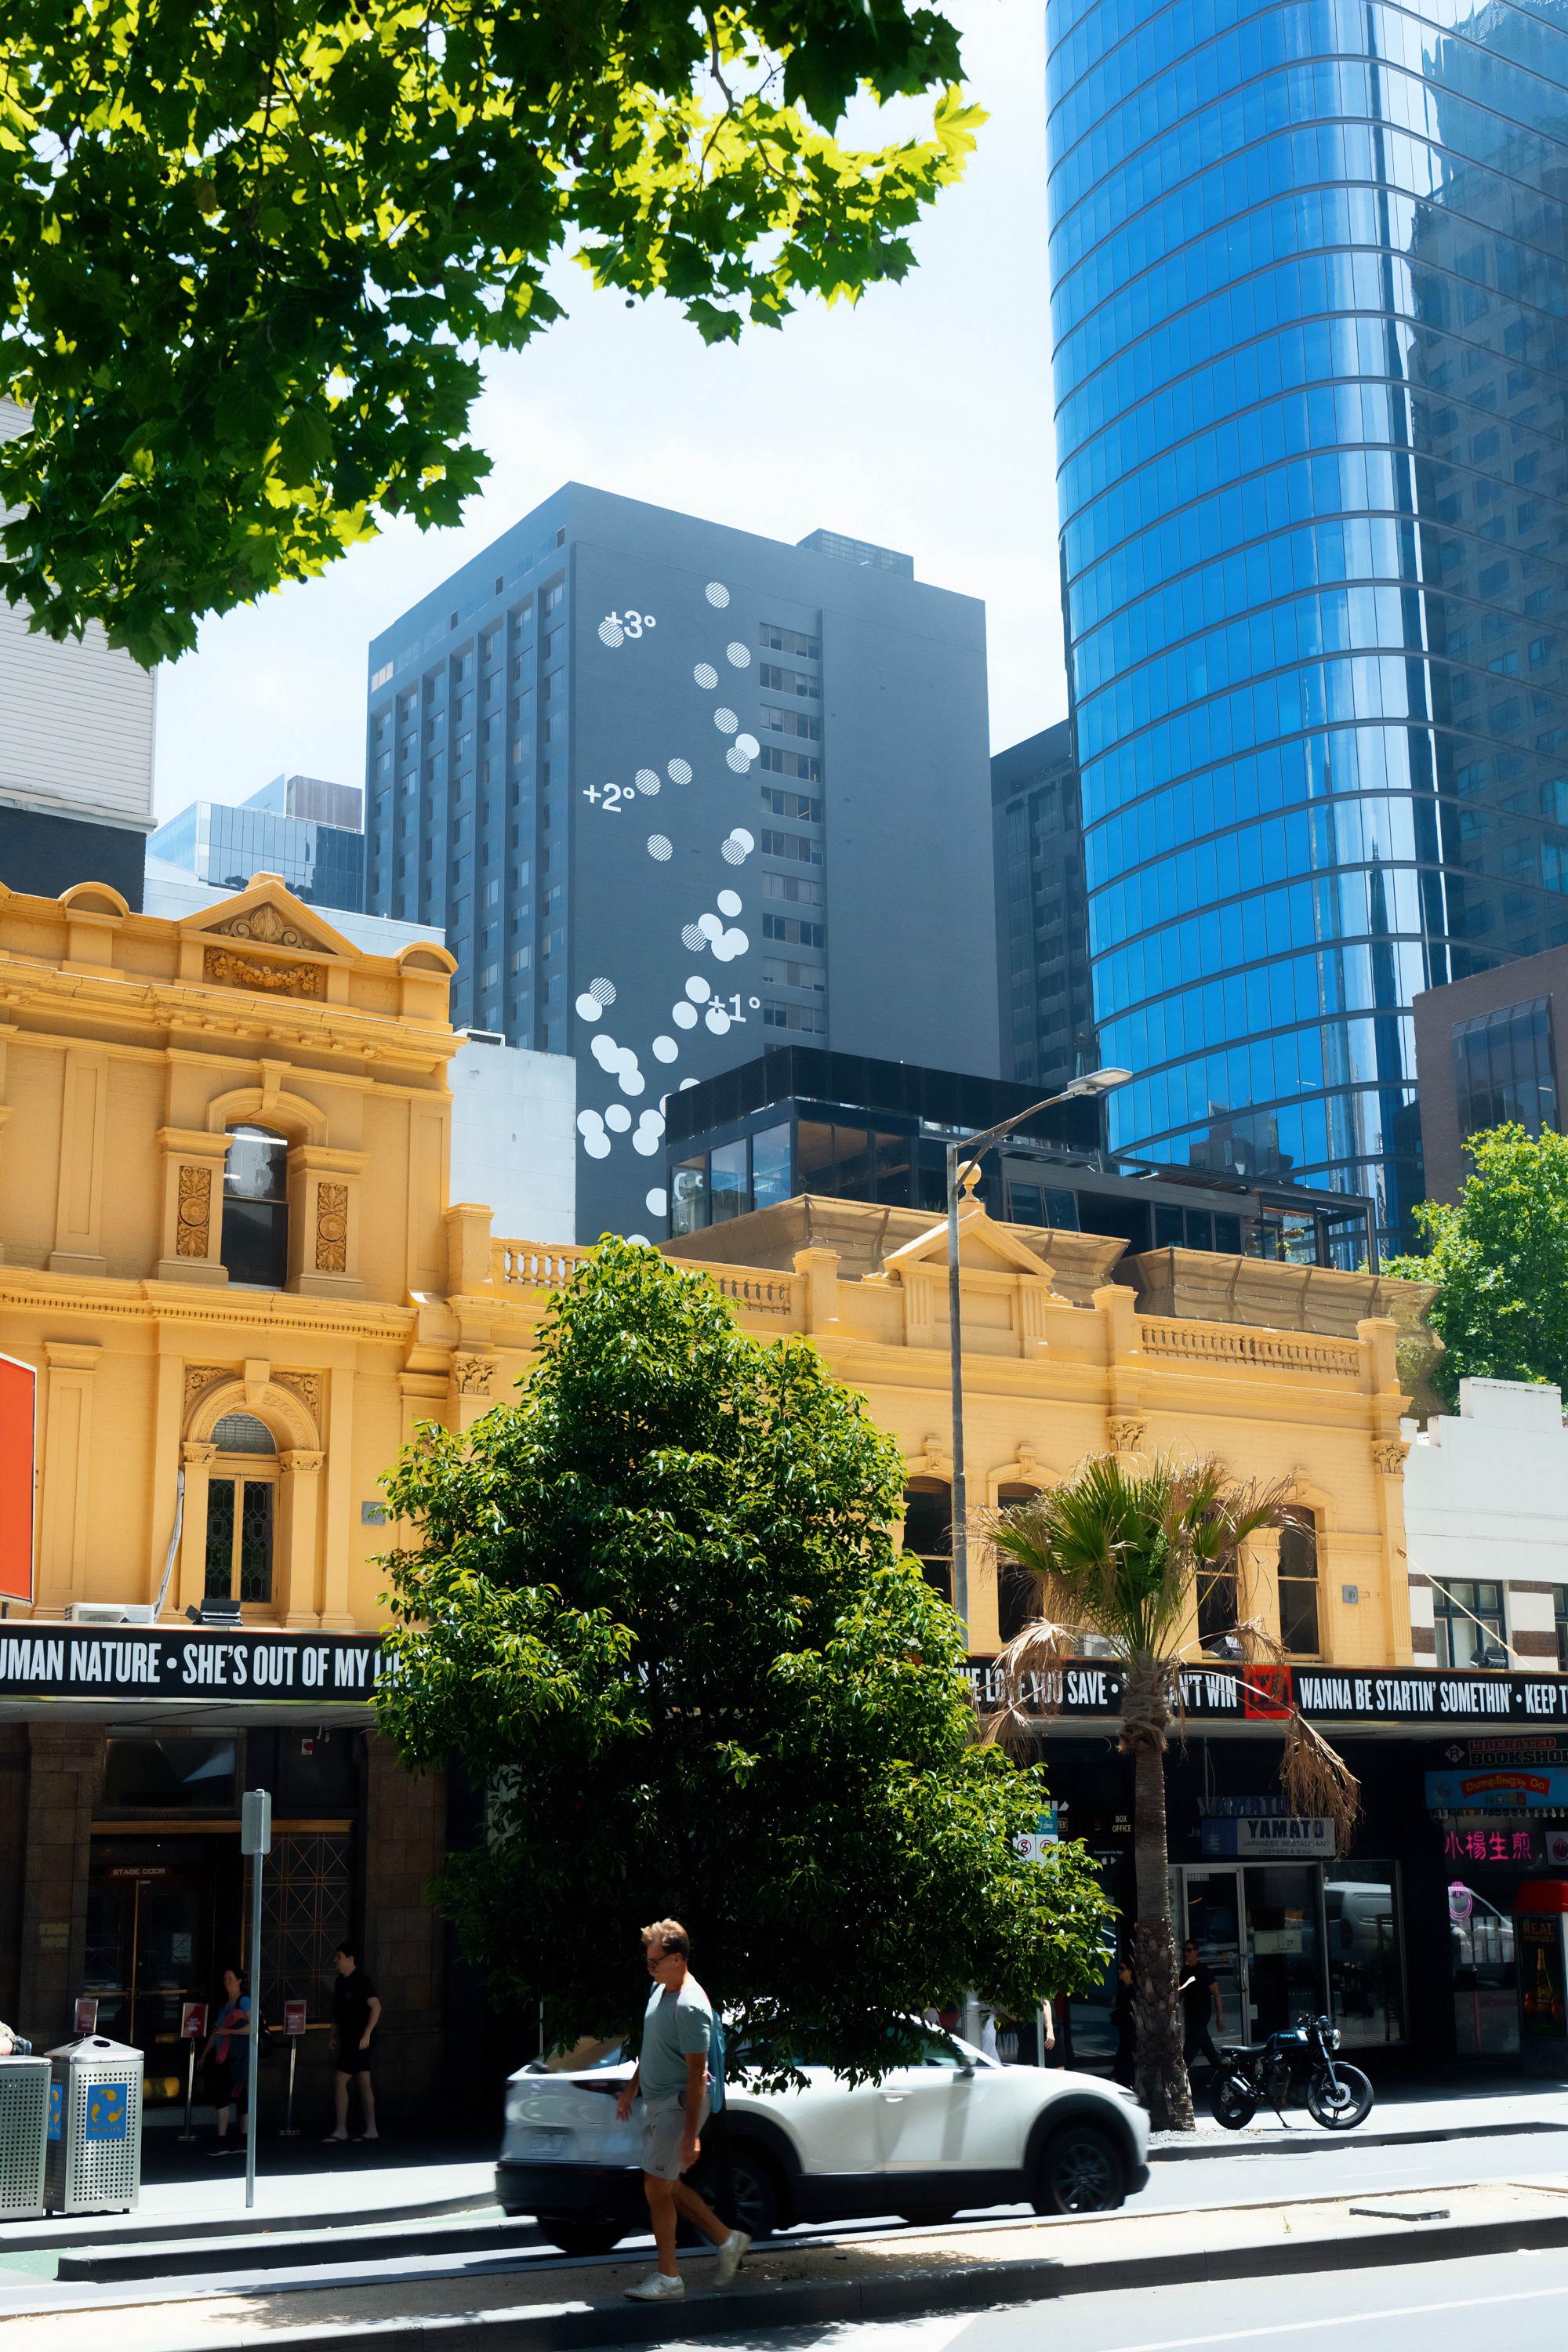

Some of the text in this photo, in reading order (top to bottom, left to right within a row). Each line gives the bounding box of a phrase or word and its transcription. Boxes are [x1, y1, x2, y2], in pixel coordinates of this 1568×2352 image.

[70, 1640, 162, 1683] NATURE
[182, 1643, 248, 1685] SHE'S
[252, 1645, 298, 1686] OUT
[302, 1646, 330, 1686] OF
[334, 1648, 369, 1687] MY
[374, 1650, 412, 1688] LIF
[1067, 1671, 1109, 1704] SAVE
[1205, 1675, 1238, 1708] WIN
[1299, 1677, 1352, 1710] WANNA
[1354, 1679, 1374, 1711] BE
[1375, 1679, 1436, 1712] STARTIN'
[1439, 1681, 1512, 1713] SOMETHIN'
[1524, 1683, 1558, 1714] KEEP
[1468, 1737, 1557, 1751] LIBERATED
[1465, 1775, 1523, 1792] Dumplings
[1530, 1777, 1546, 1791] Go
[1112, 1824, 1132, 1833] OFFICE
[1247, 1820, 1325, 1838] YAMATO
[1444, 1831, 1533, 1860] 小楊生煎
